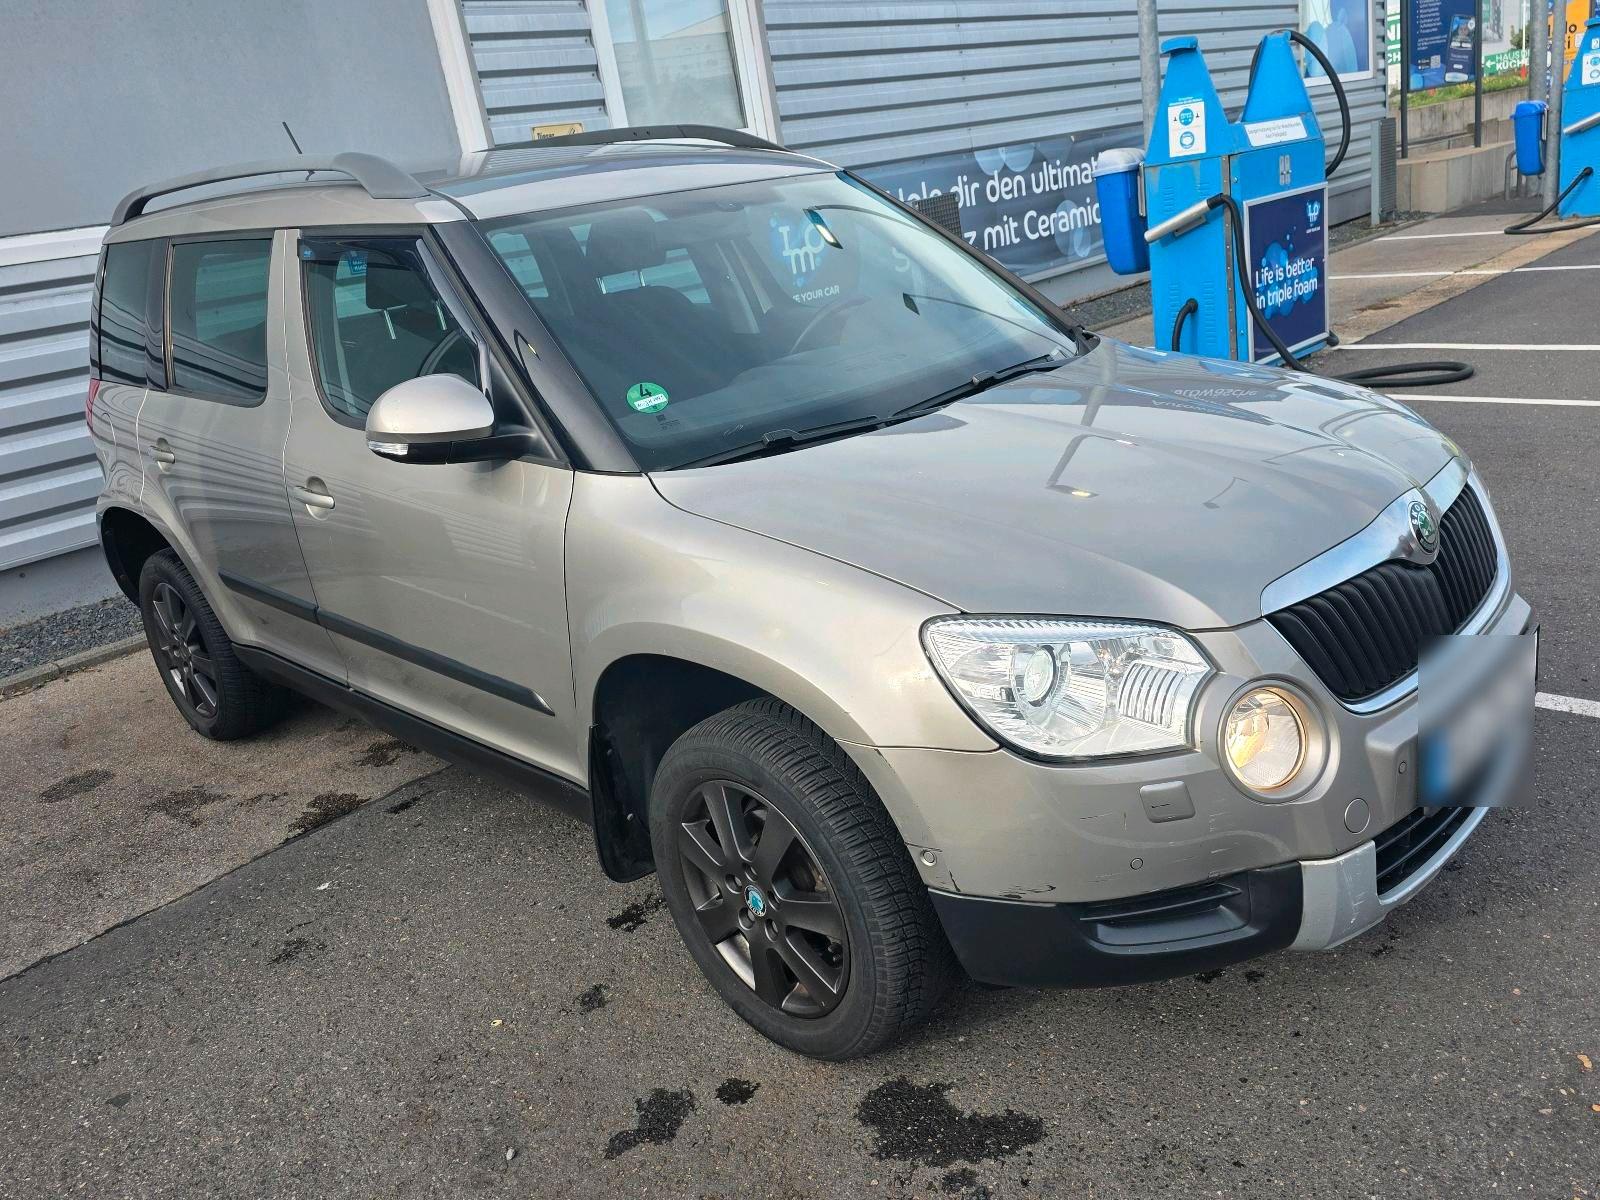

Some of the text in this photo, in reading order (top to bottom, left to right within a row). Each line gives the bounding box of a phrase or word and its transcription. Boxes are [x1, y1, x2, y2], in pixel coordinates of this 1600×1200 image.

[950, 174, 979, 209] dir
[986, 170, 1027, 204] den
[1031, 155, 1099, 194] ultimat
[984, 196, 1102, 250] mit Ceramic
[1255, 257, 1315, 288] Life is better
[800, 288, 823, 303] YOUR
[824, 284, 840, 298] CAR
[1255, 277, 1318, 310] in triple foam
[640, 383, 652, 397] 4
